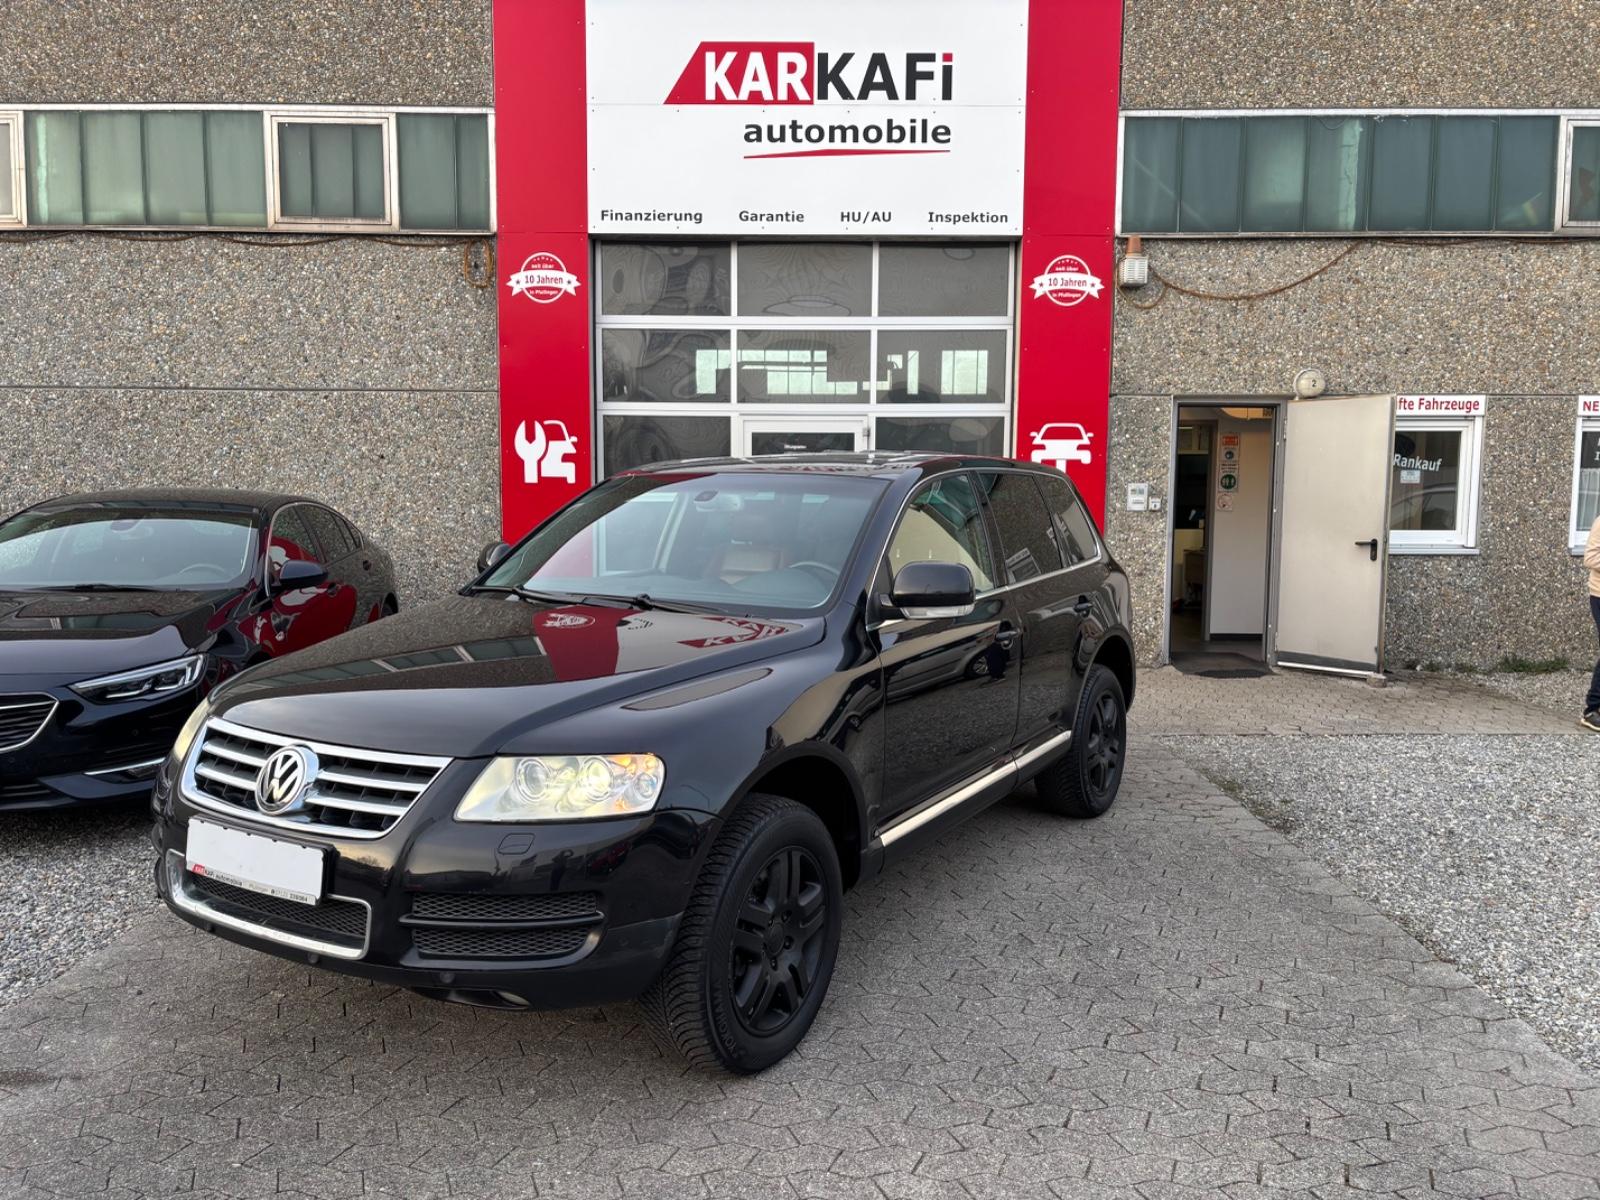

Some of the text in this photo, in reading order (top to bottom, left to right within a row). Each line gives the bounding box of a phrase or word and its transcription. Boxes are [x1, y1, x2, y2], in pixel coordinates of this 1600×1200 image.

[704, 51, 953, 101] KARKAFi
[743, 118, 951, 144] automobile
[601, 209, 1008, 225] Finanzierung Garantie HU/AU Inspektion
[525, 275, 563, 284] 10 Jahren
[1048, 277, 1087, 287] 10 Jahren
[1311, 379, 1318, 388] 2
[1396, 397, 1480, 413] fte Fahrzeuge
[1583, 400, 1600, 411] NE
